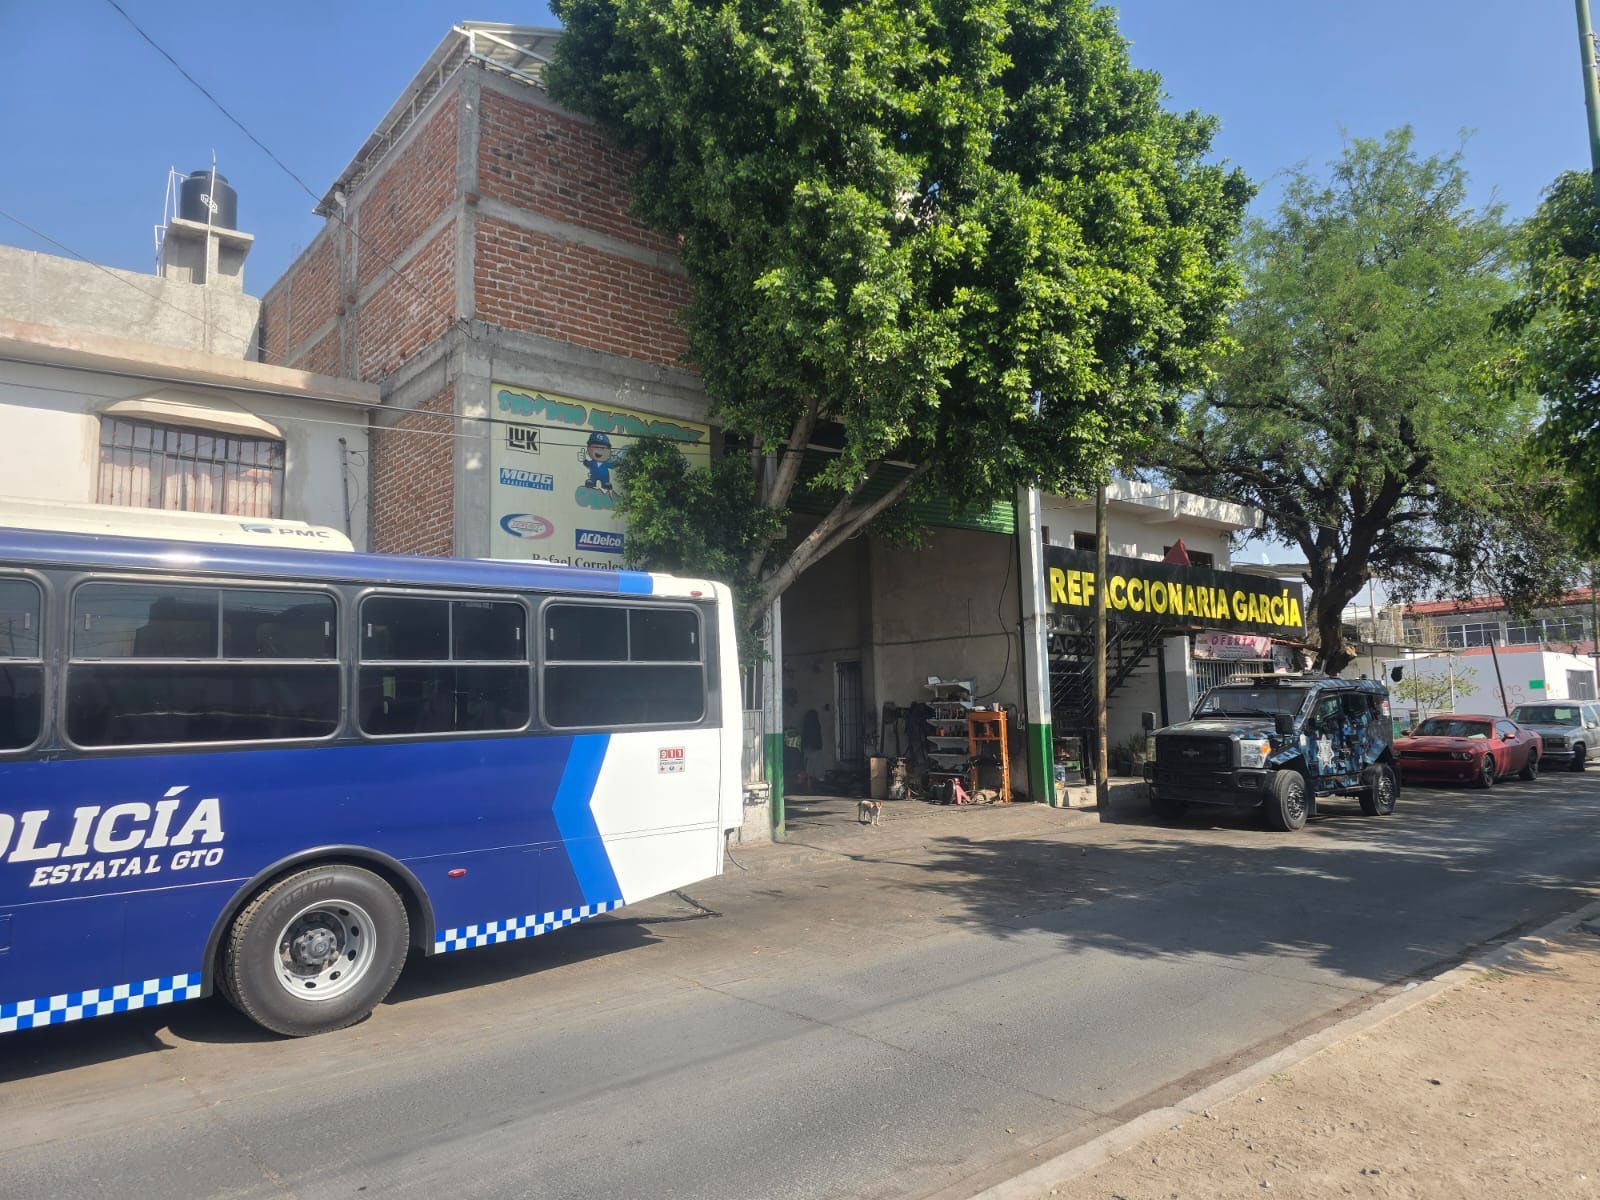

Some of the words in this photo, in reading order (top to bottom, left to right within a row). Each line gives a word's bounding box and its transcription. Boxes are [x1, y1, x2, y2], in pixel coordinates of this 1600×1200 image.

[501, 469, 553, 485] MOOG
[279, 528, 330, 538] PMC
[579, 532, 622, 547] ACDelco
[1232, 588, 1303, 628] GARCÍA
[1211, 635, 1258, 647] OFERTA
[0, 785, 225, 863] LICÍA
[28, 854, 162, 888] ESTATAL
[170, 847, 225, 871] GTO
